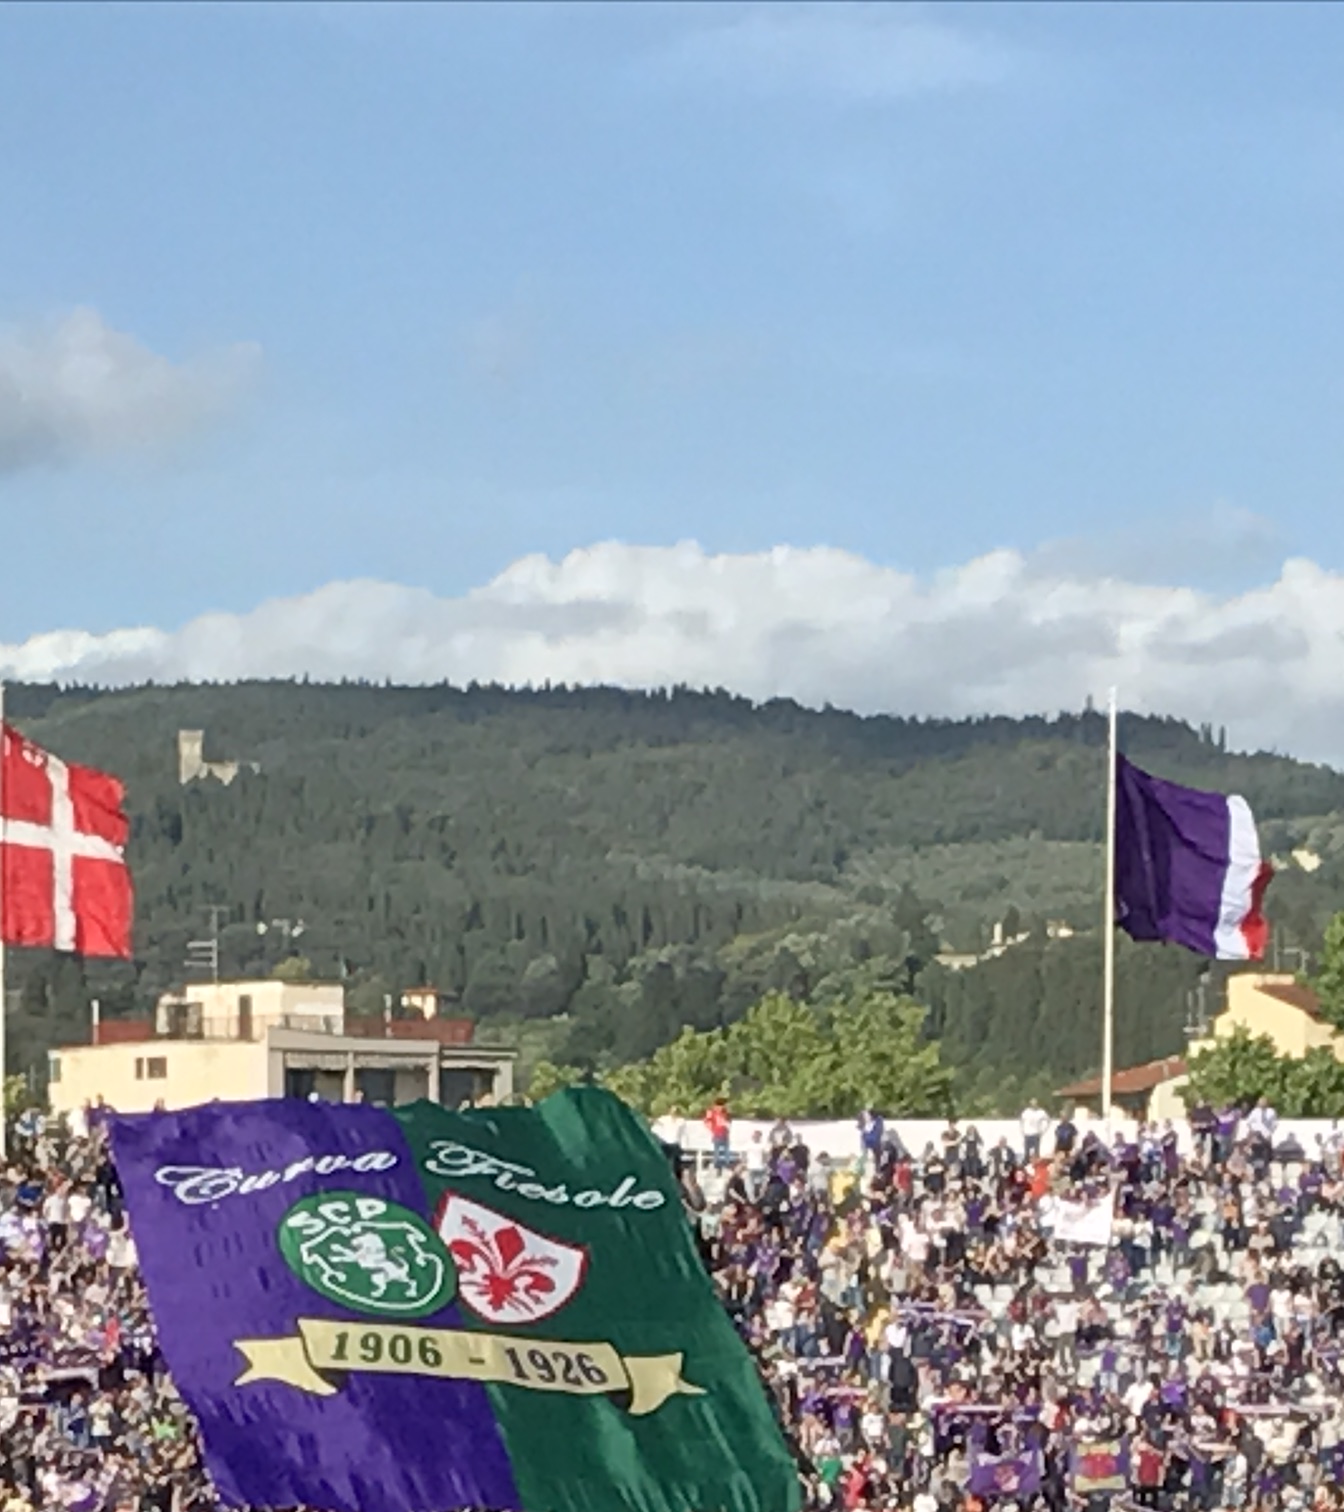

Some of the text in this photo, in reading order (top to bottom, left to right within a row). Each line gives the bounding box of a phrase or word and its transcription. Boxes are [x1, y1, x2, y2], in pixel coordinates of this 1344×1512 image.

[155, 1139, 667, 1211] Curva Fiesole
[329, 1331, 443, 1369] 1906
[505, 1346, 607, 1386] 1926
